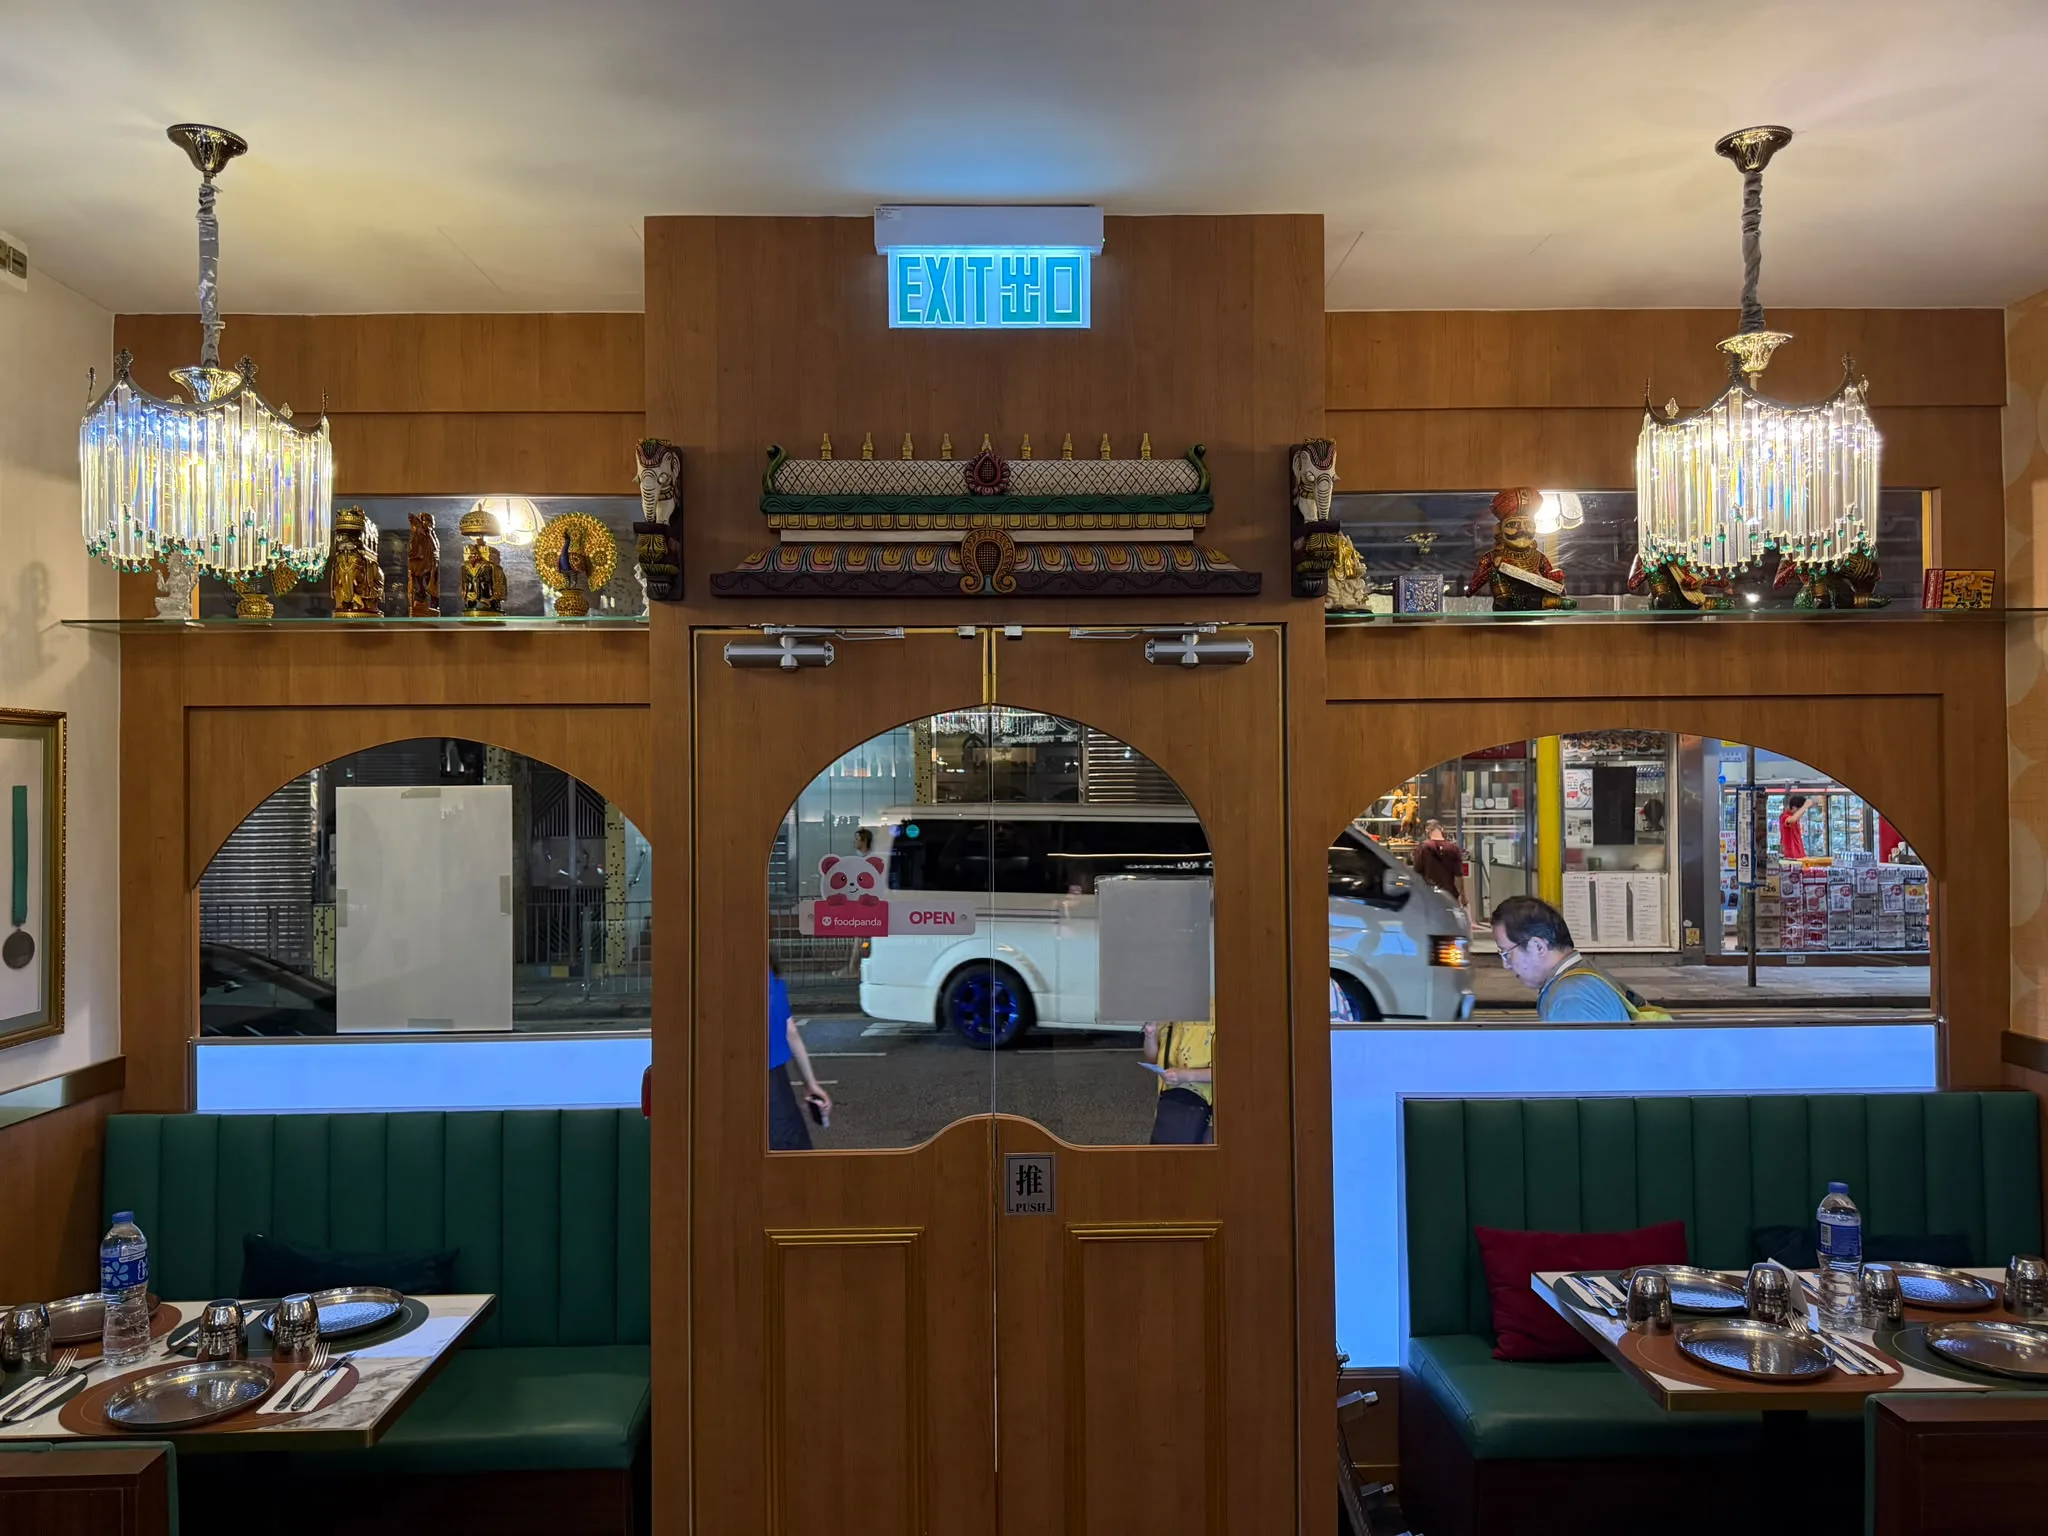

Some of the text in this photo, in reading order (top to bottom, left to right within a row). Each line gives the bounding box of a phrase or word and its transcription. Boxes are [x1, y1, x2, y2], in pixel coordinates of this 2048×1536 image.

[898, 255, 1082, 324] EXIT 出口
[834, 917, 882, 927] foodpanda
[909, 911, 955, 925] OPEN
[1016, 1165, 1044, 1196] 推
[1016, 1203, 1046, 1212] PUSH
